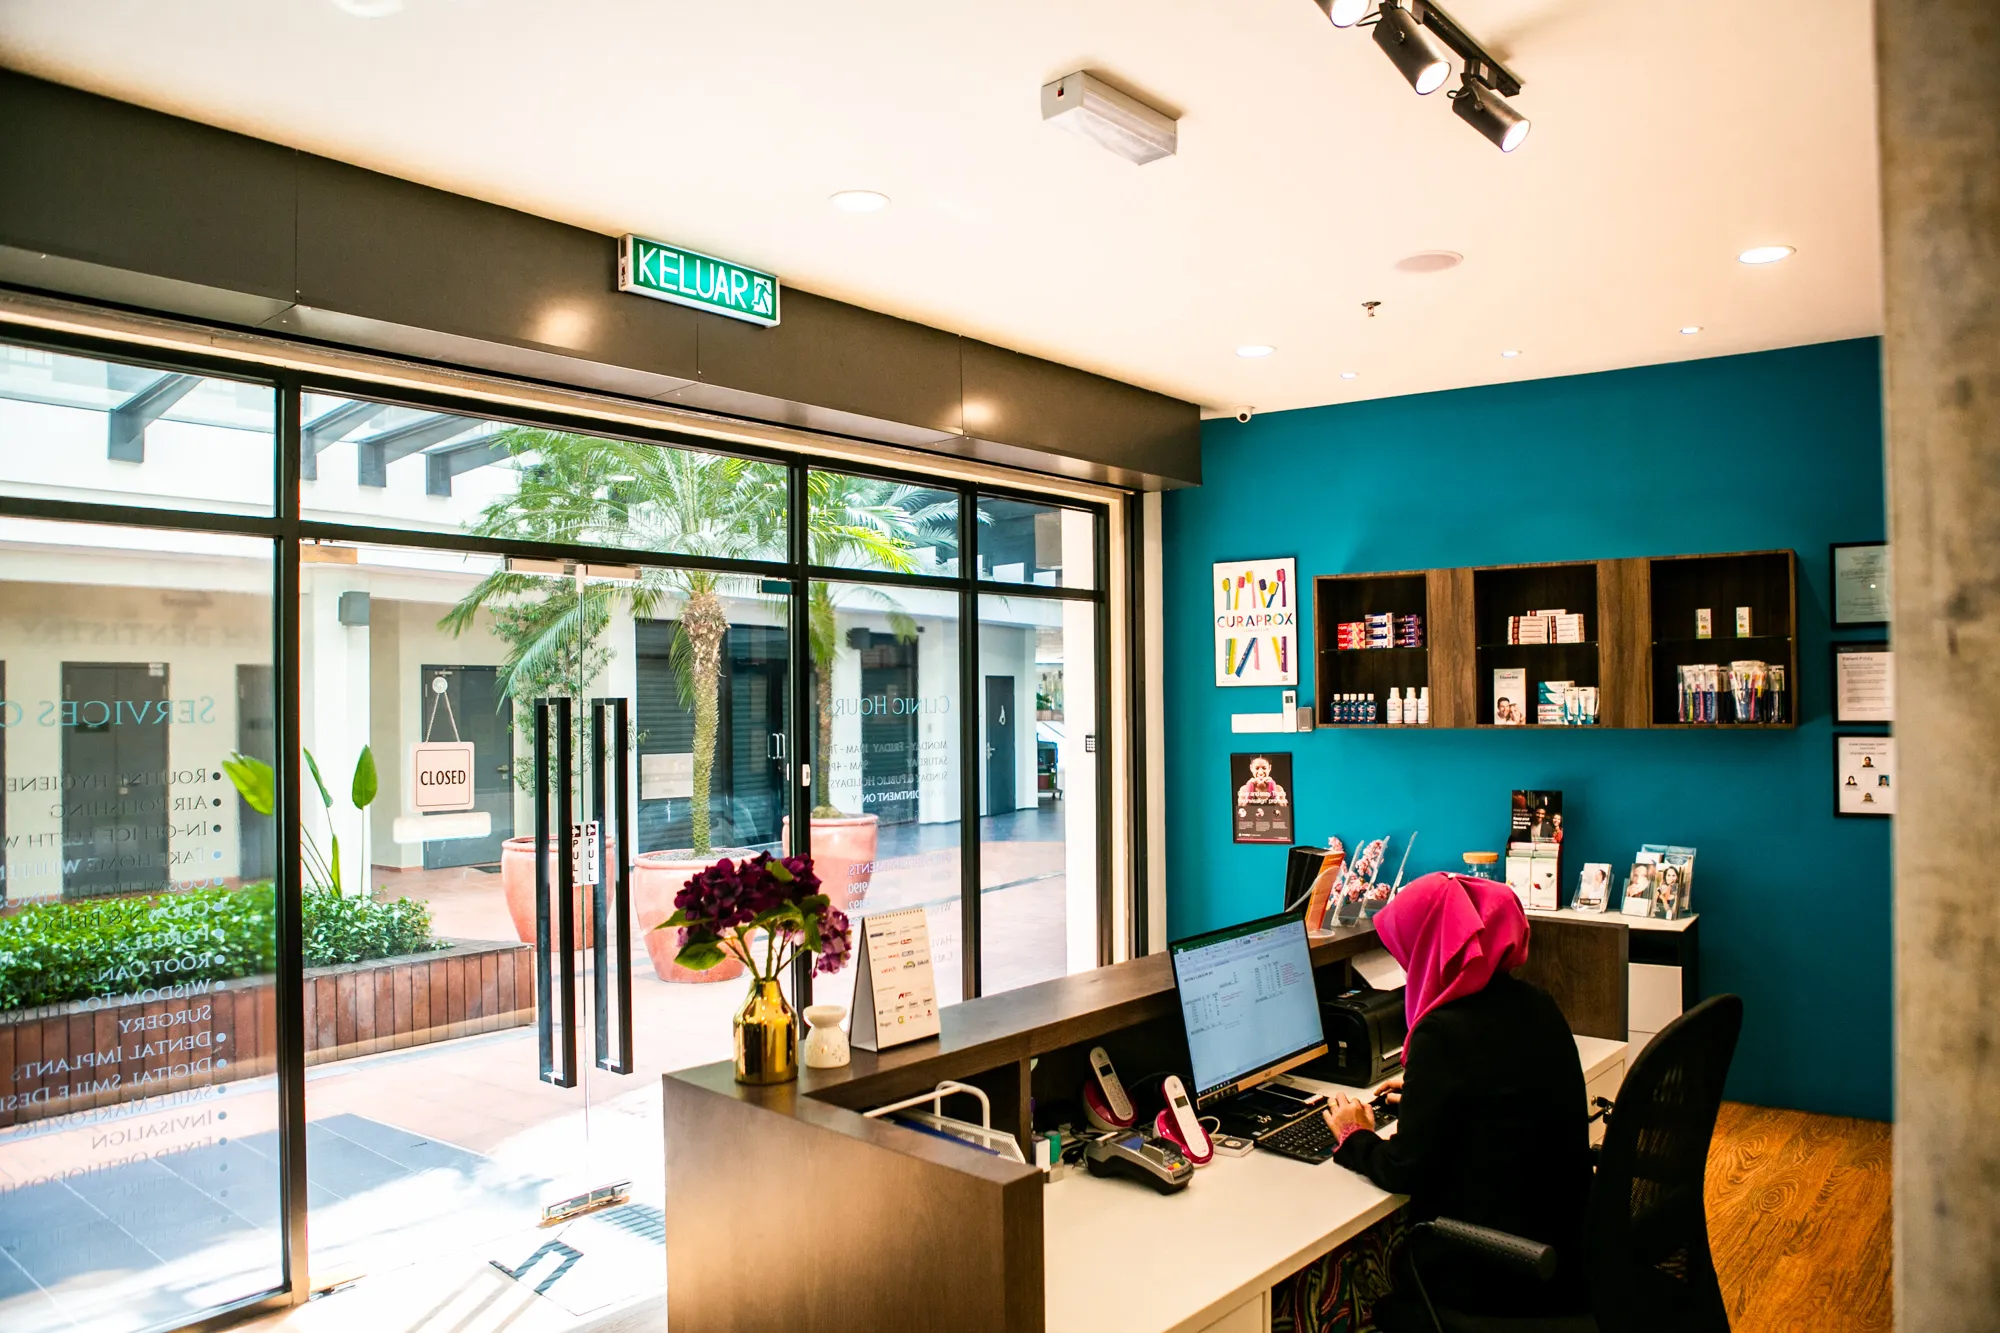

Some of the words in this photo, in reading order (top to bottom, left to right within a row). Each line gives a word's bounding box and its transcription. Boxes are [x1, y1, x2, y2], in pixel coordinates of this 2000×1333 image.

[639, 244, 749, 310] KELUAR
[1217, 613, 1293, 628] CURAPROX
[420, 770, 466, 786] CLOSED
